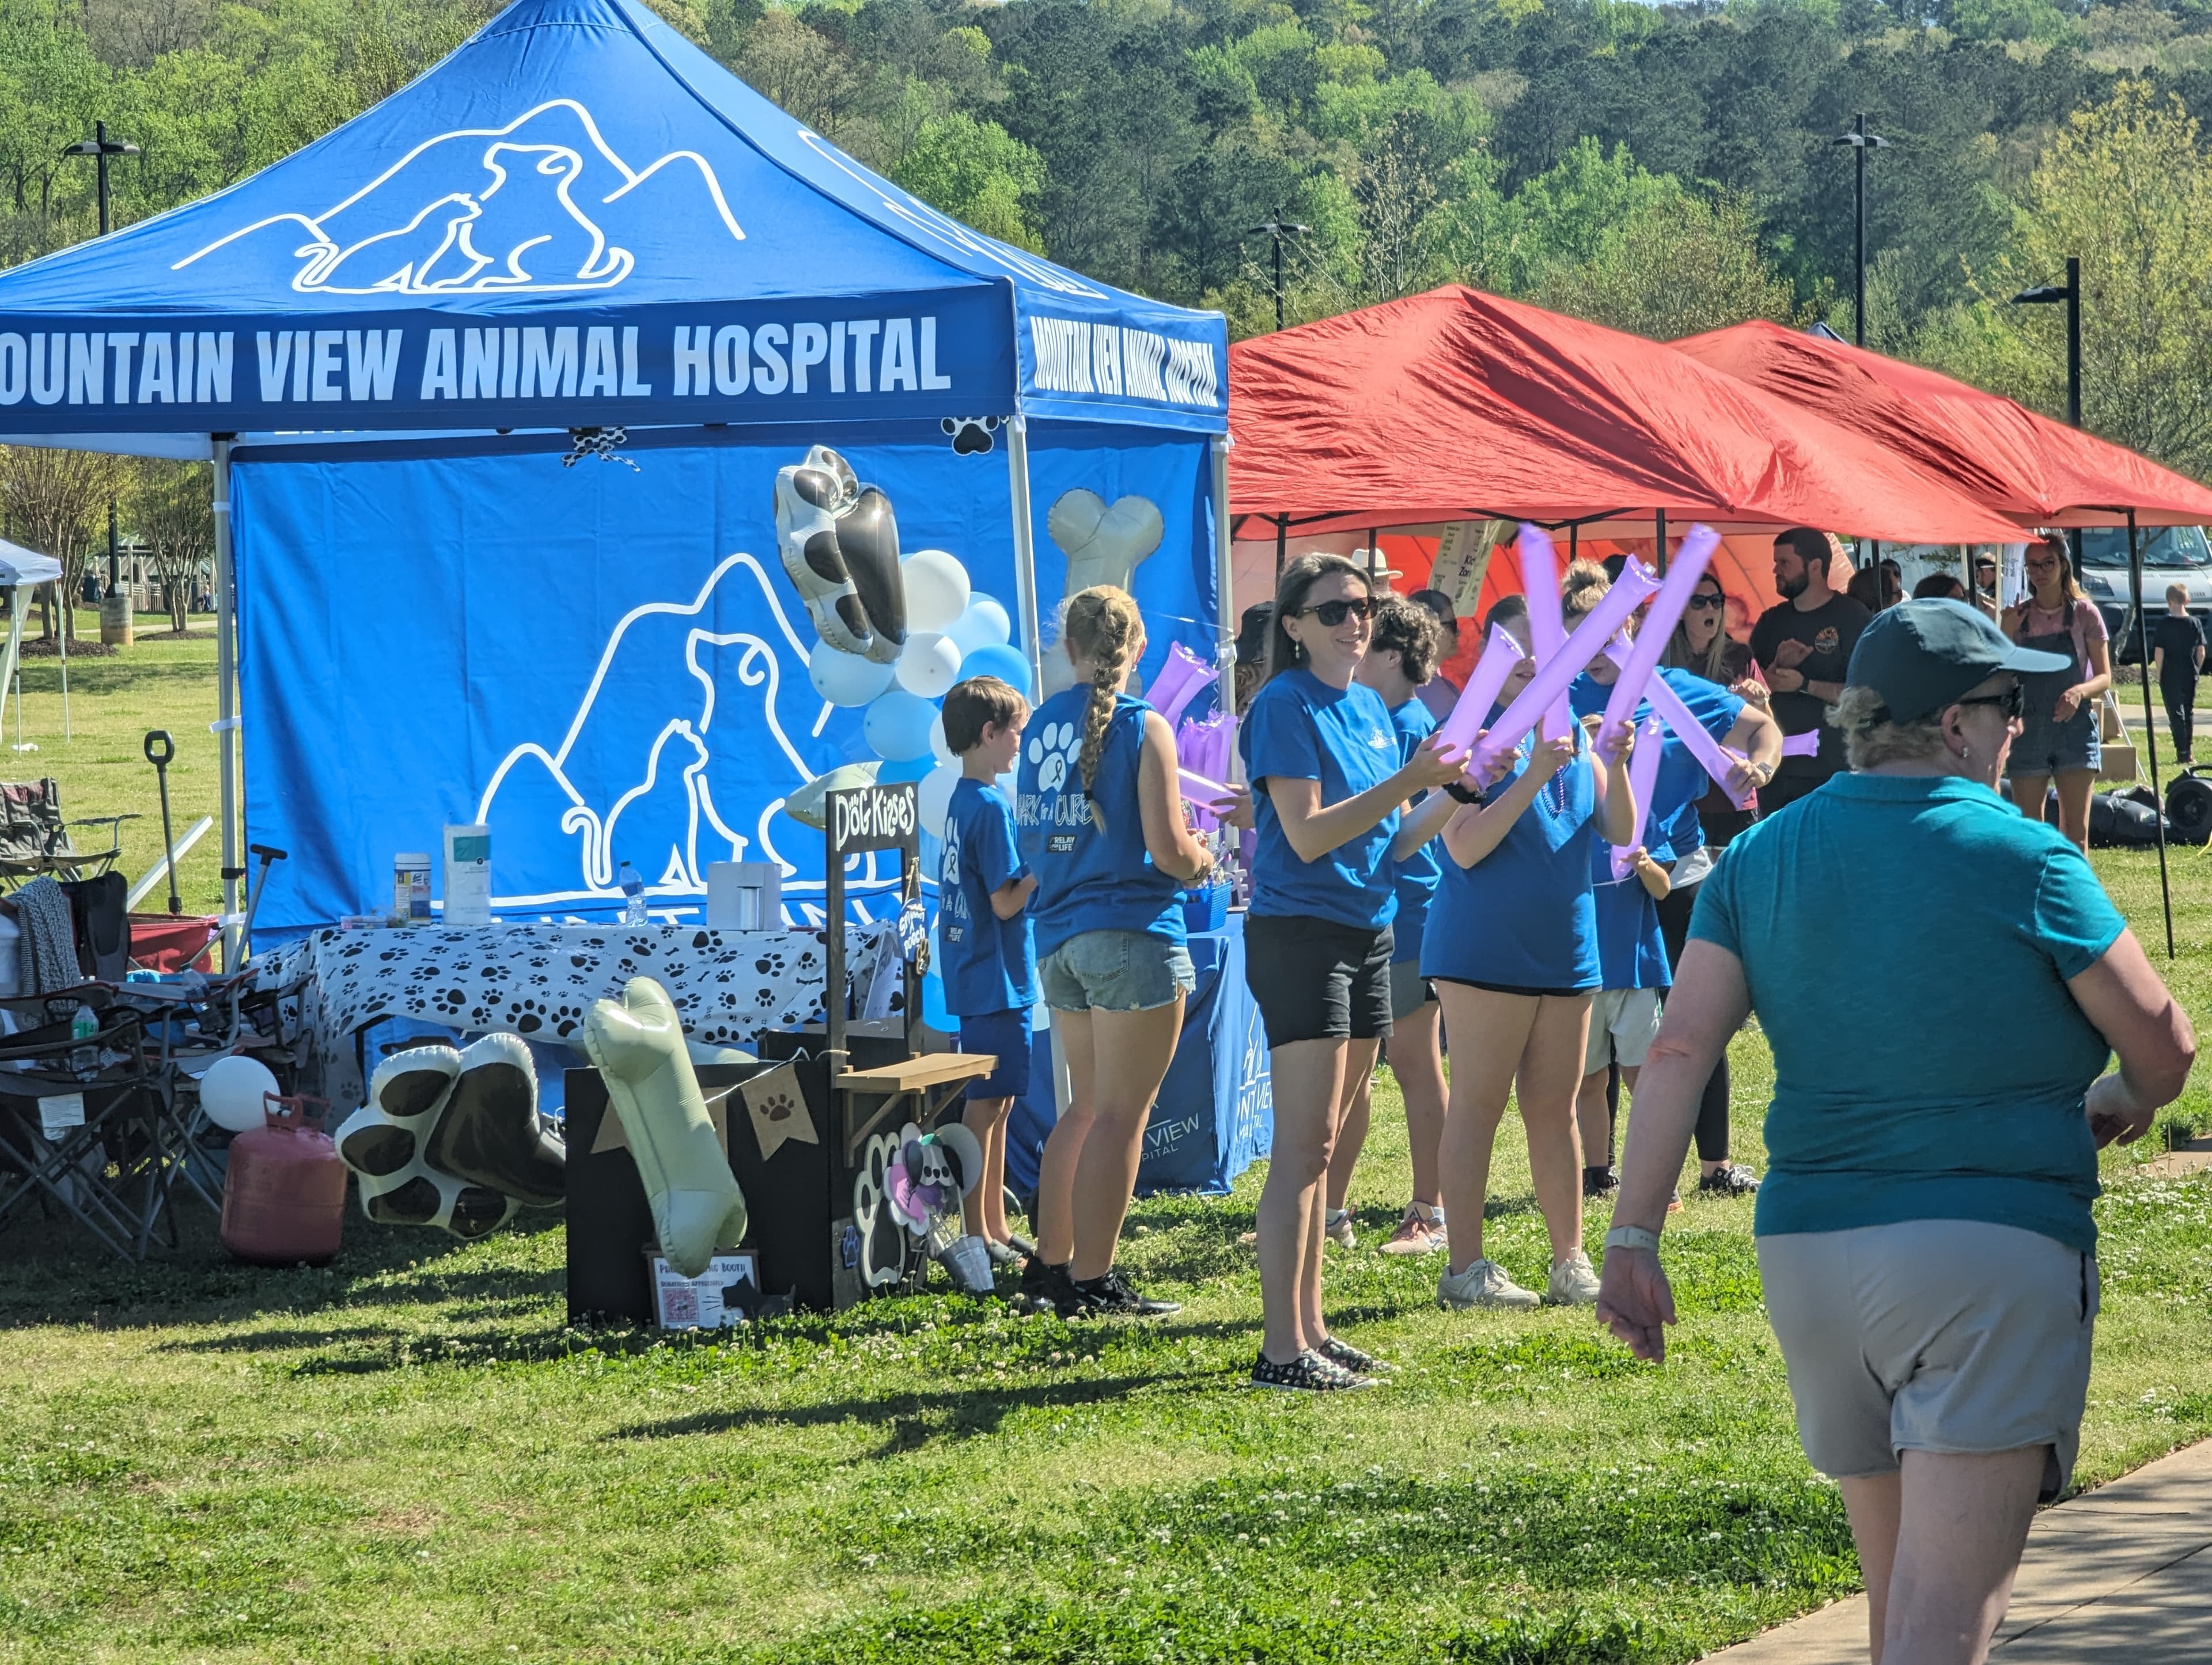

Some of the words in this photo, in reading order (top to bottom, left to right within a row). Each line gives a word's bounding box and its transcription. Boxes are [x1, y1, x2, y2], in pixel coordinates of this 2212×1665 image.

[0, 332, 233, 405] OUNTAIN
[256, 329, 403, 402] VIEW
[421, 327, 652, 400] ANIMAL
[673, 316, 952, 396] HOSPITAL
[1030, 316, 1094, 392] MOUNTAIN
[1093, 324, 1123, 395] VIEW
[1123, 328, 1167, 401] ANIMAL
[1165, 337, 1218, 408] HOSPITAL
[1055, 794, 1093, 826] CURE
[1146, 1112, 1199, 1147] VIEW
[1142, 1144, 1179, 1162] PITAL
[722, 1262, 746, 1272] BOOTH
